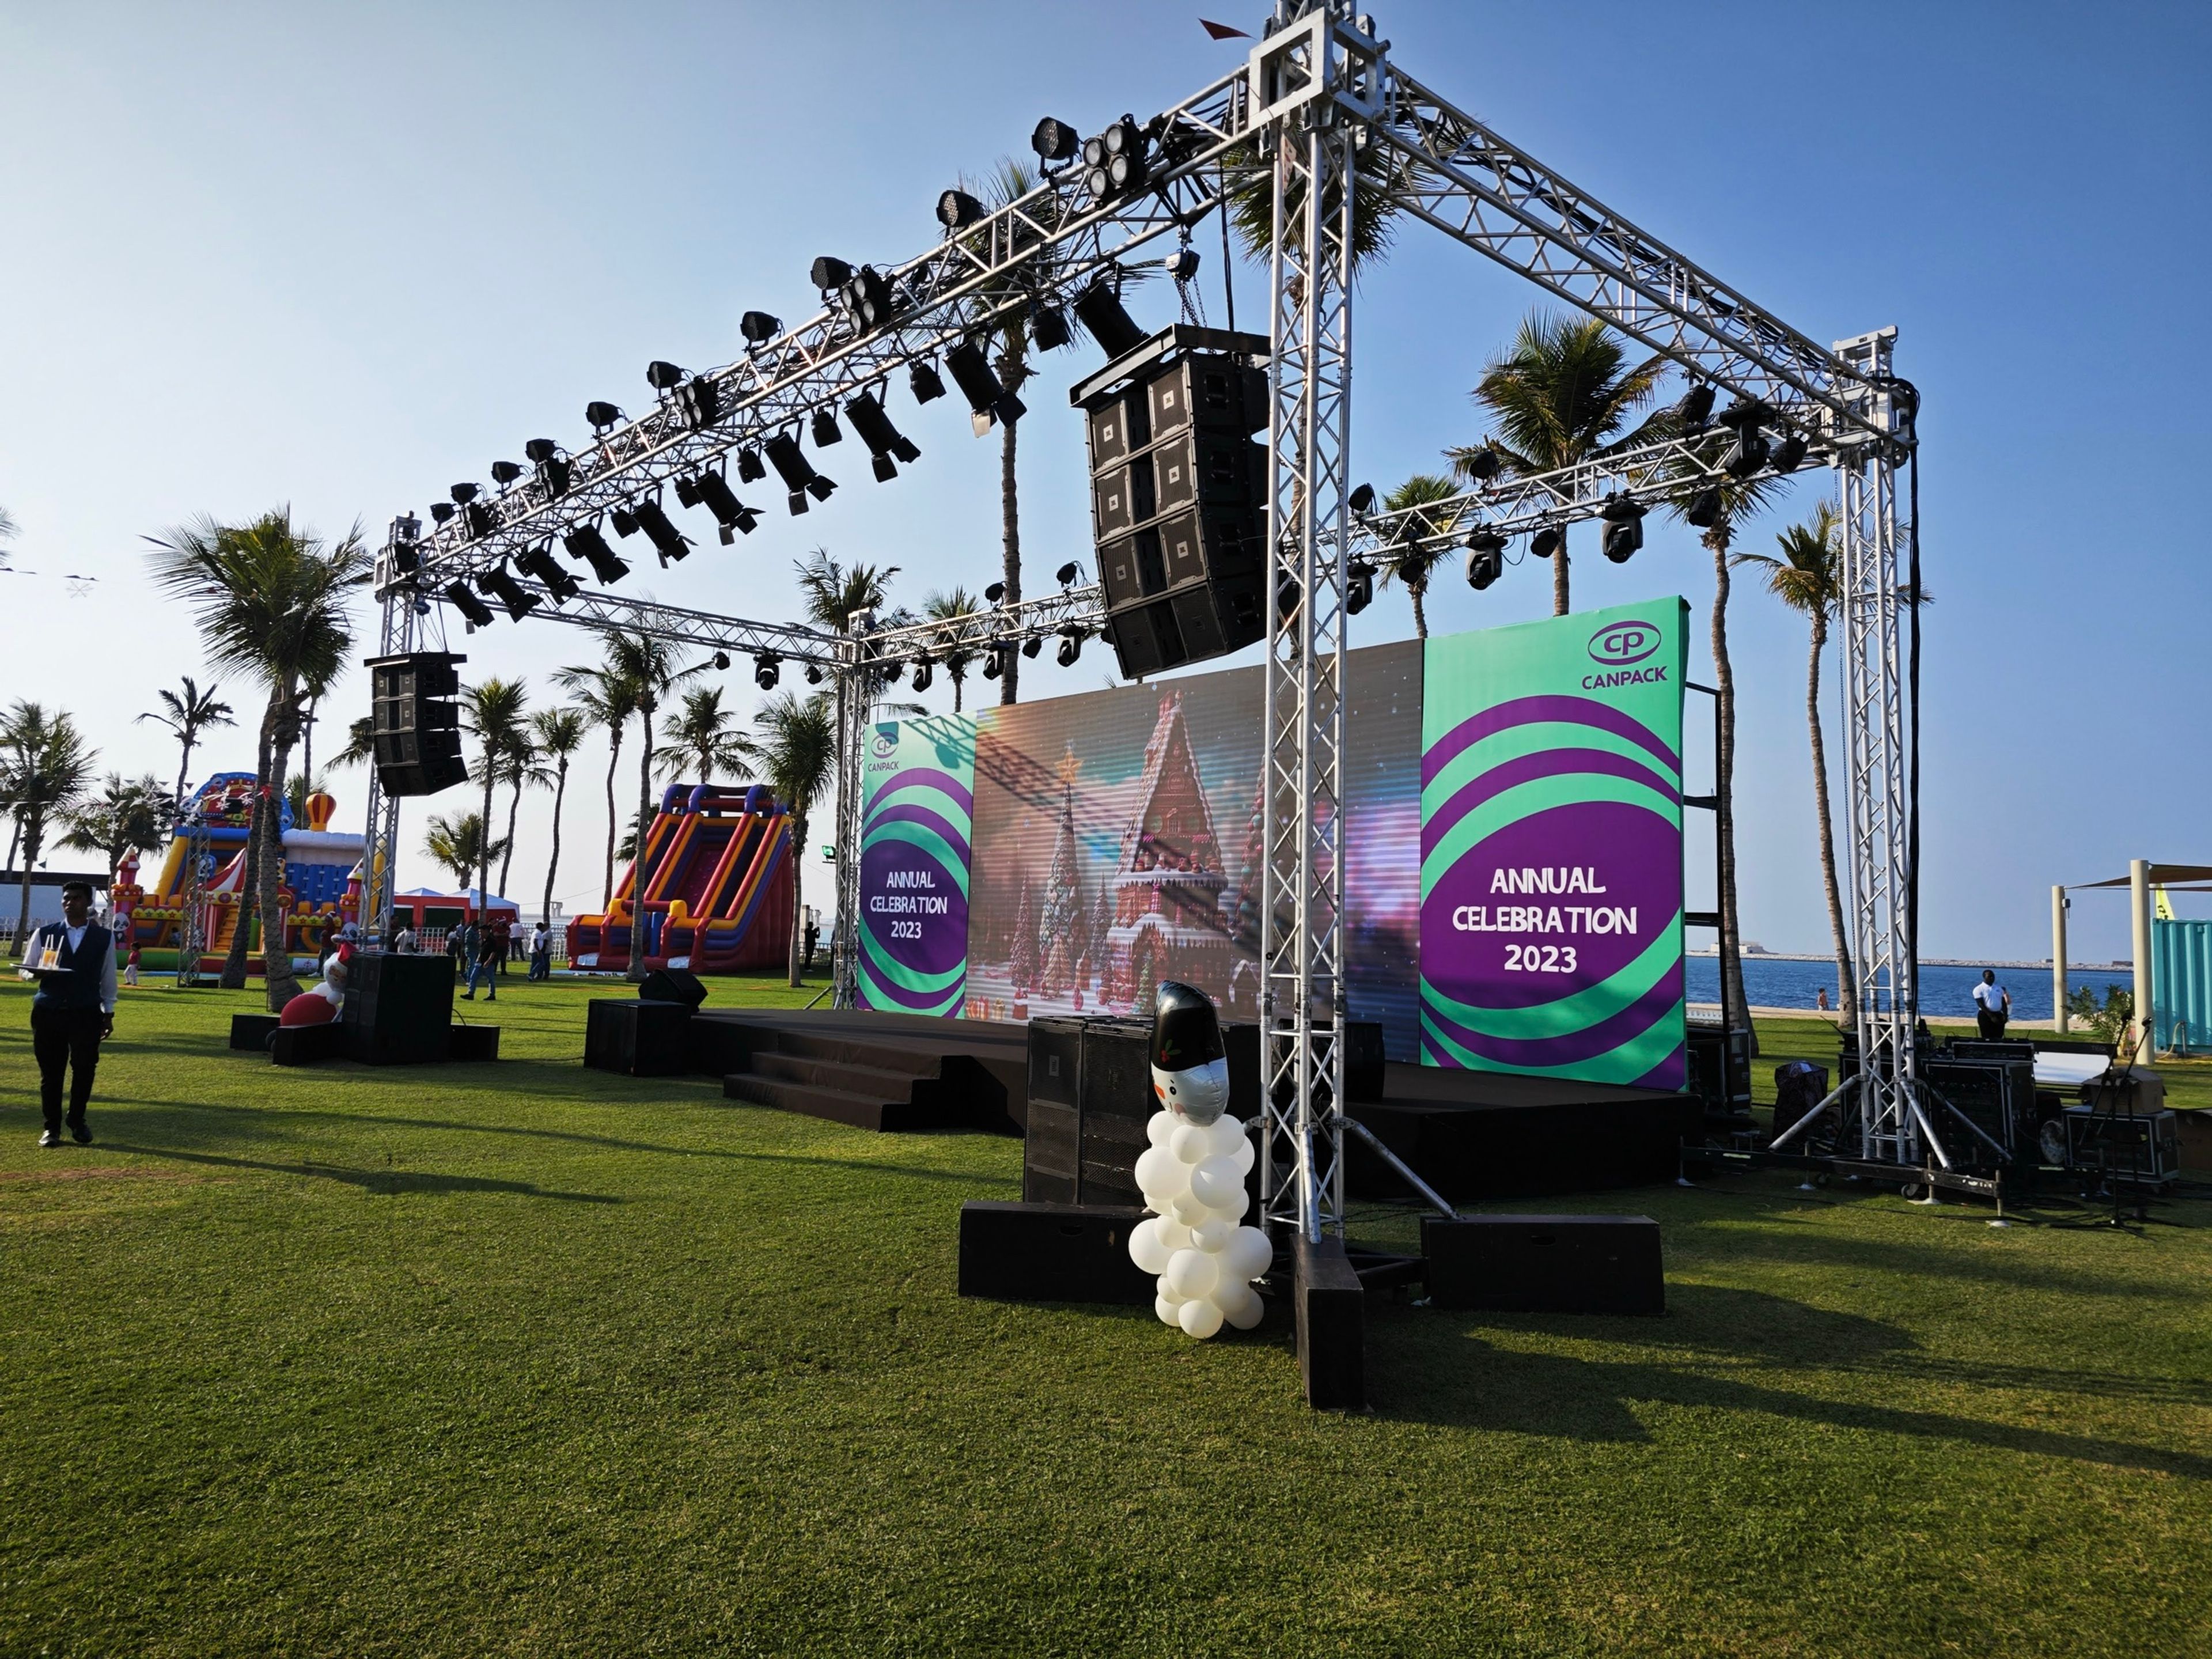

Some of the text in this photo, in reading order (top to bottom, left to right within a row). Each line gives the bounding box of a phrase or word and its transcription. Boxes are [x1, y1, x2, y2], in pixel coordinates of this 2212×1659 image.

[1582, 666, 1668, 690] CANPACK
[868, 760, 899, 772] CANPACK
[886, 871, 936, 889] ANNUAL
[1490, 866, 1607, 894] ANNUAL
[870, 896, 948, 915] CELEBRATION
[891, 921, 922, 939] 2023
[1452, 906, 1637, 934] CELEBRATION
[1504, 944, 1577, 974] 2023
